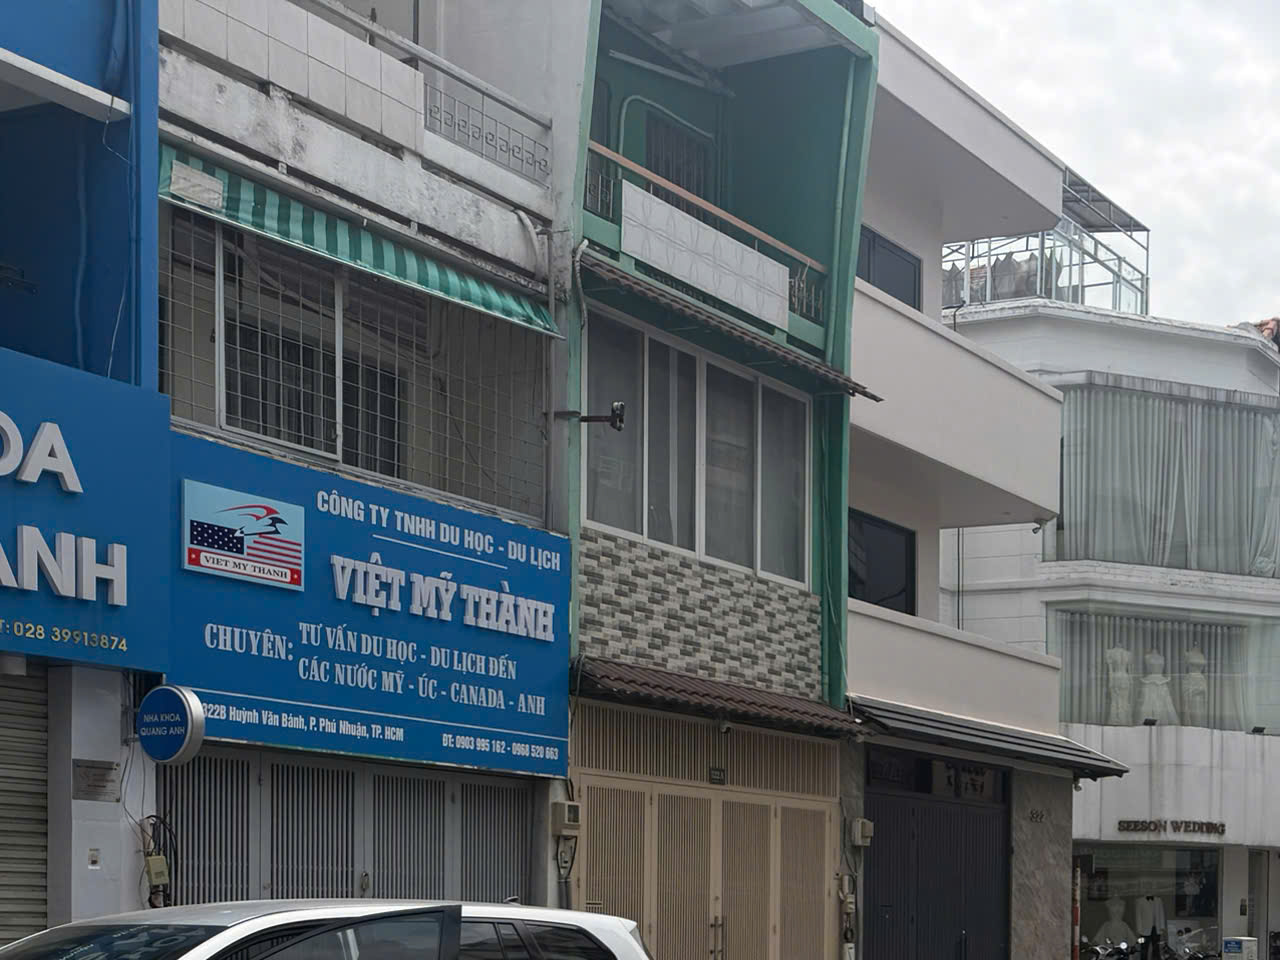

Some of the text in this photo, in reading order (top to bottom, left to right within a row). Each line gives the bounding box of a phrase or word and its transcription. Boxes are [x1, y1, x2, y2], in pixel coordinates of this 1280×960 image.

[316, 490, 365, 522] CÔNG
[369, 504, 390, 528] TY
[395, 511, 436, 540] TNHH
[440, 522, 460, 546] DU
[464, 530, 494, 555] HỌC
[507, 540, 527, 563] DU
[530, 546, 561, 571] LỊCH
[0, 525, 128, 606] NH
[203, 555, 288, 579] VIET MY THANH
[330, 552, 555, 642] VIỆT MỸ THÀNH
[13, 623, 46, 640] 028
[51, 627, 128, 653] 39913874
[204, 623, 294, 662] CHUYÊN:
[298, 622, 323, 647] TƯ
[325, 623, 358, 653] VẤN
[360, 633, 383, 658] DU
[386, 638, 417, 665] HỌC
[430, 646, 450, 669] DU
[452, 650, 486, 675] LỊCH
[488, 653, 517, 680] ĐẾN
[298, 656, 330, 683] CÁC
[334, 662, 377, 690] NƯỚC
[381, 670, 405, 694] MỸ
[417, 673, 438, 699] ÚC
[450, 682, 505, 710] CANADA
[517, 692, 545, 716] ANH
[140, 726, 185, 736] QUANG ANH
[143, 713, 181, 723] NHA KHOA
[202, 703, 404, 742] 322B Huỳnh Văn Bánh, P. Phú Nhuận, TP. HCM
[455, 735, 475, 750] 0903
[476, 737, 490, 752] 995
[1118, 820, 1226, 836] SEESON WEDDING
